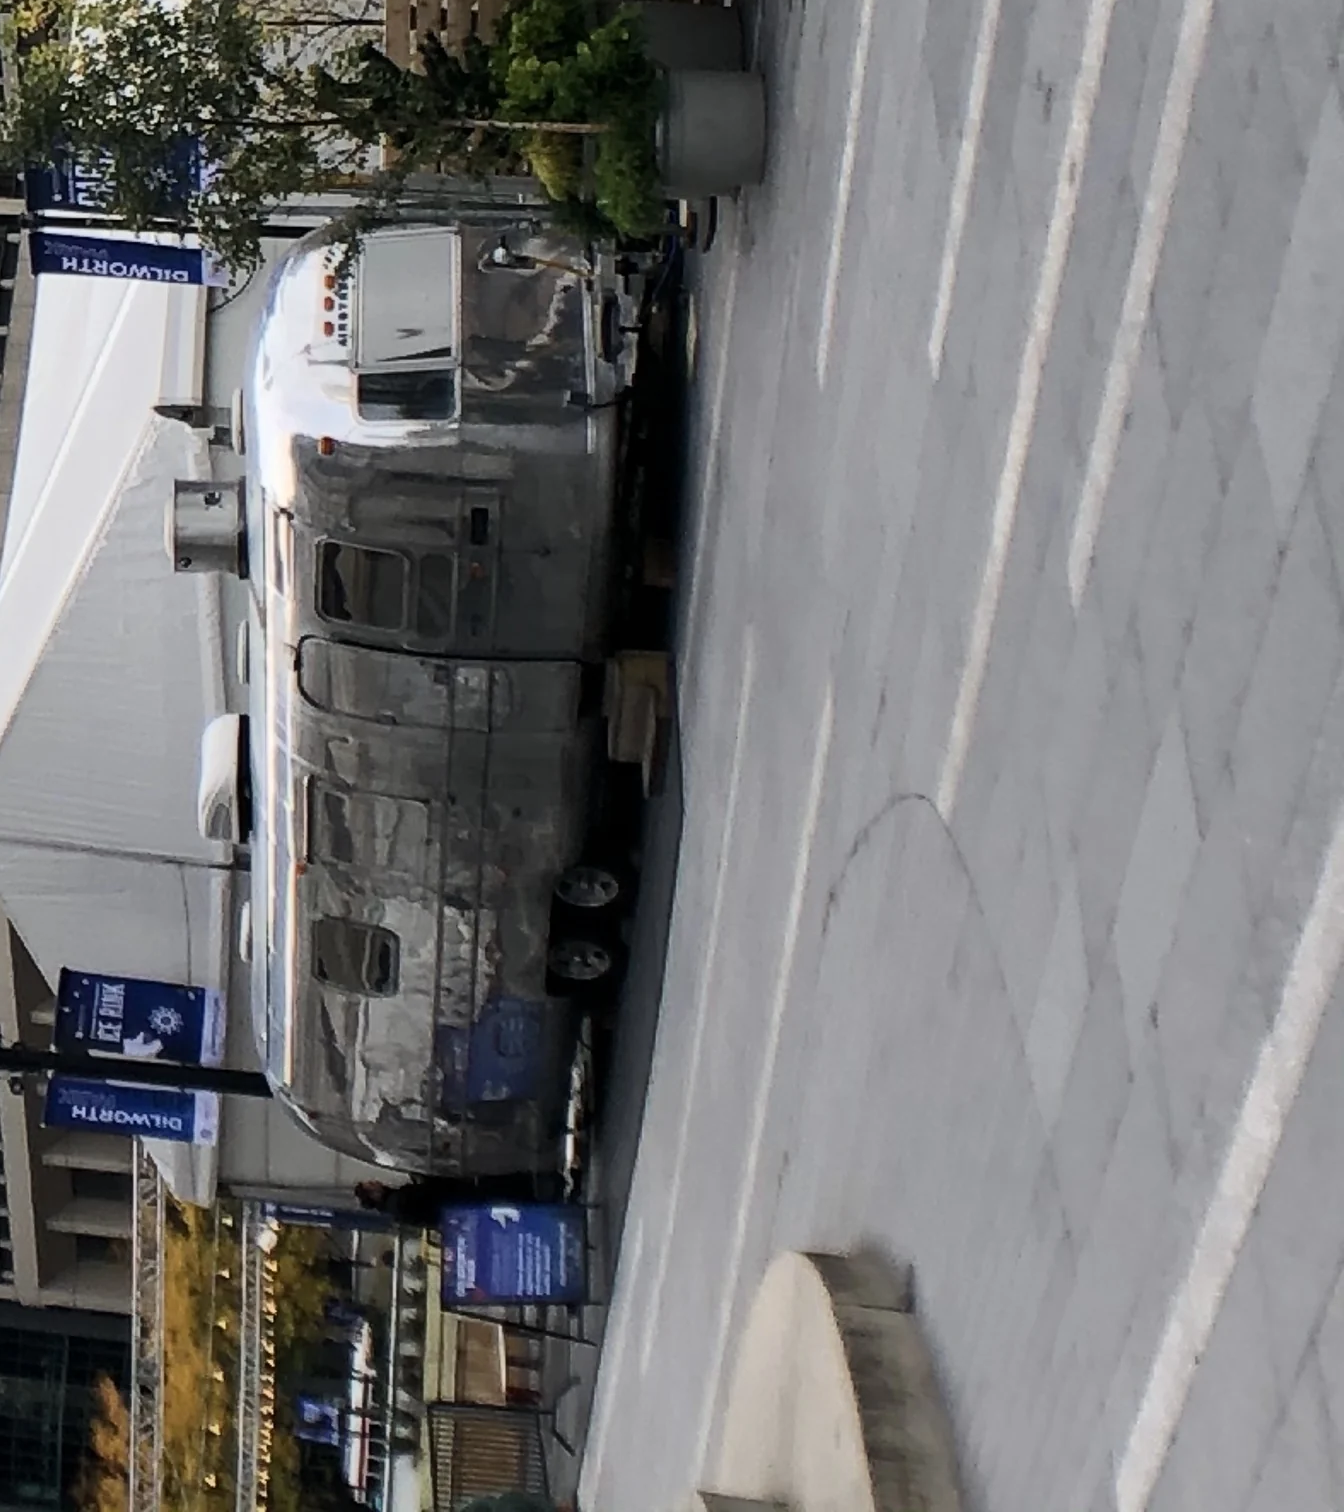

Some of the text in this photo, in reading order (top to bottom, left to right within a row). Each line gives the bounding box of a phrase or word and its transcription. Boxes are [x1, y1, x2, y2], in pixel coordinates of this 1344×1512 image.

[61, 256, 189, 282] DILWORTH
[96, 983, 125, 1043] ICE RINK
[71, 1105, 182, 1132] DILWORTH
